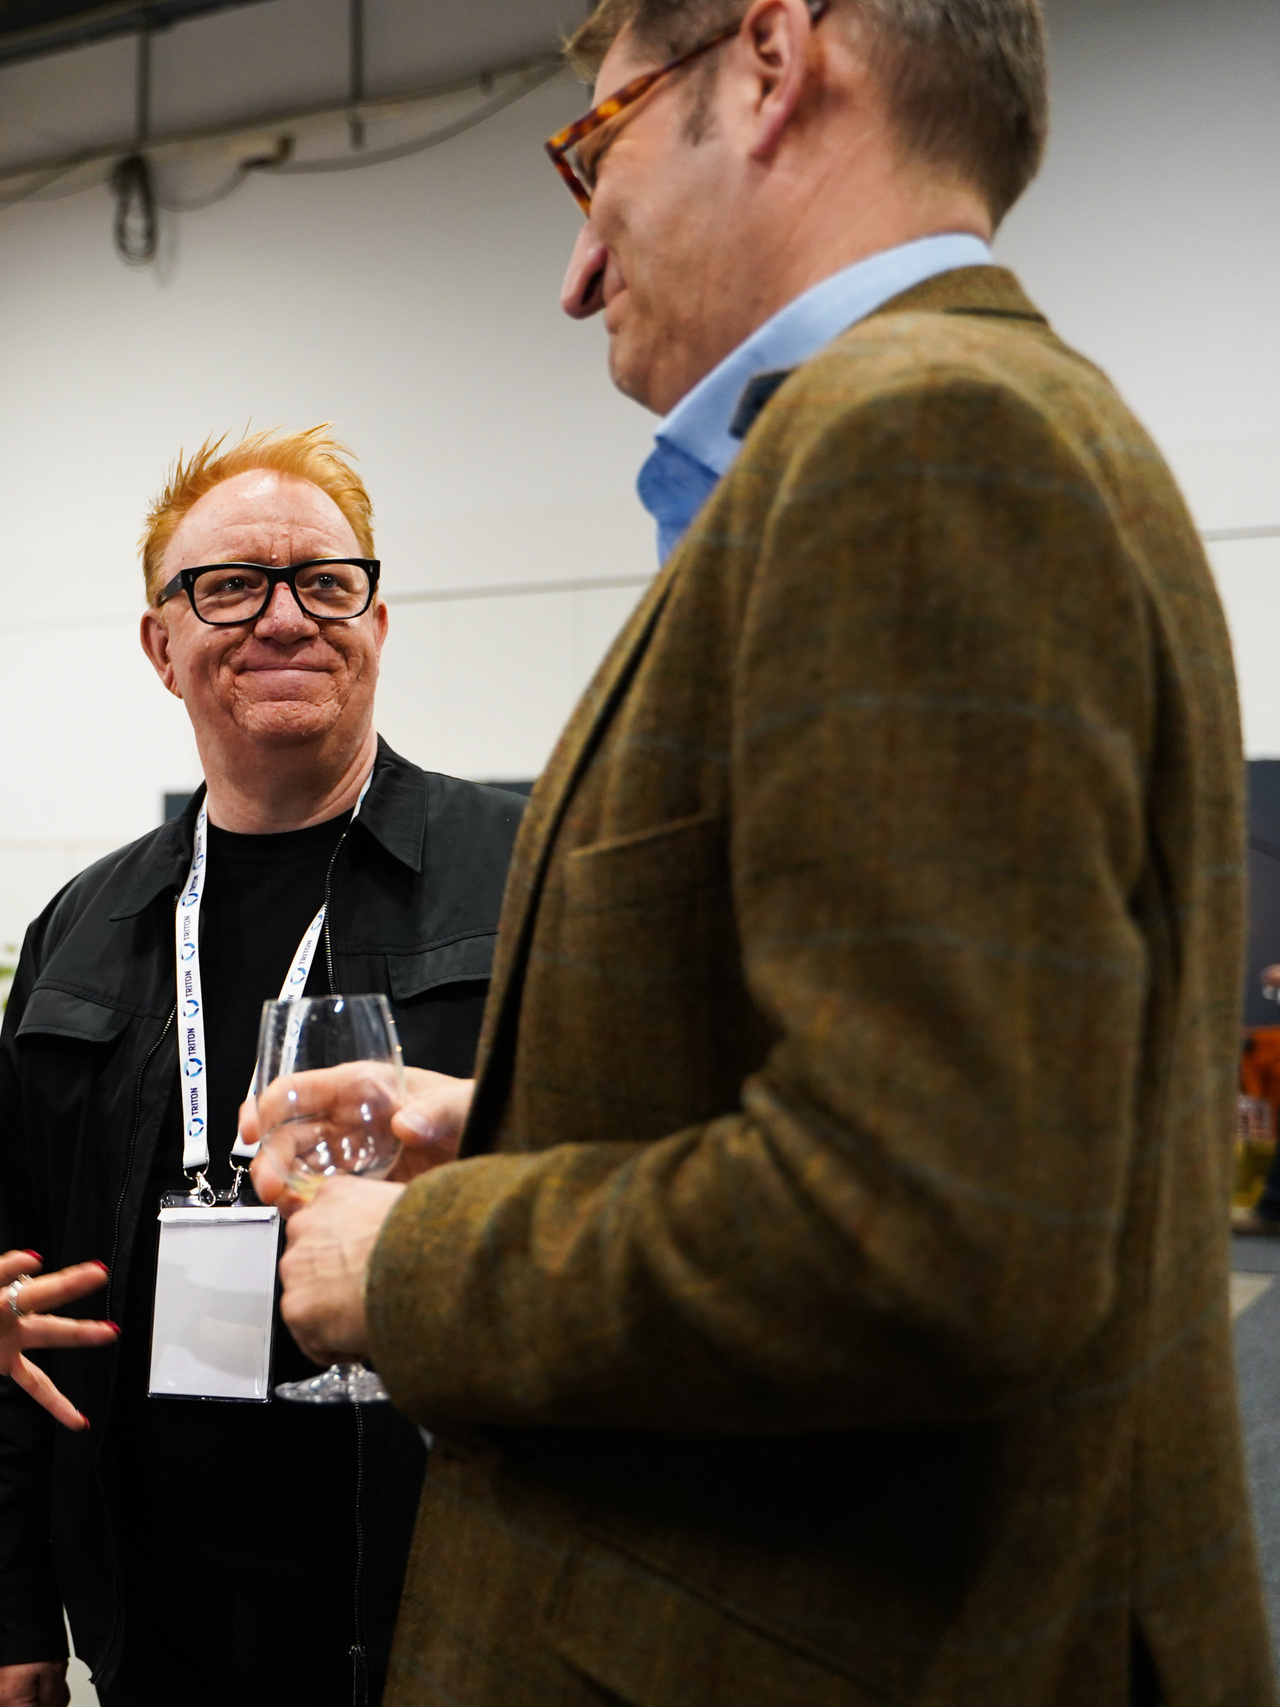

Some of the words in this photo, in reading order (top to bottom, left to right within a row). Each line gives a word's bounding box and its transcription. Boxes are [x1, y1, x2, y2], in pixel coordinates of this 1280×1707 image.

[183, 915, 192, 942] TRITON
[298, 939, 313, 966] TRITON
[185, 970, 193, 998] TRITON
[187, 1027, 196, 1057] TRITON
[190, 1087, 199, 1117] TRITON
